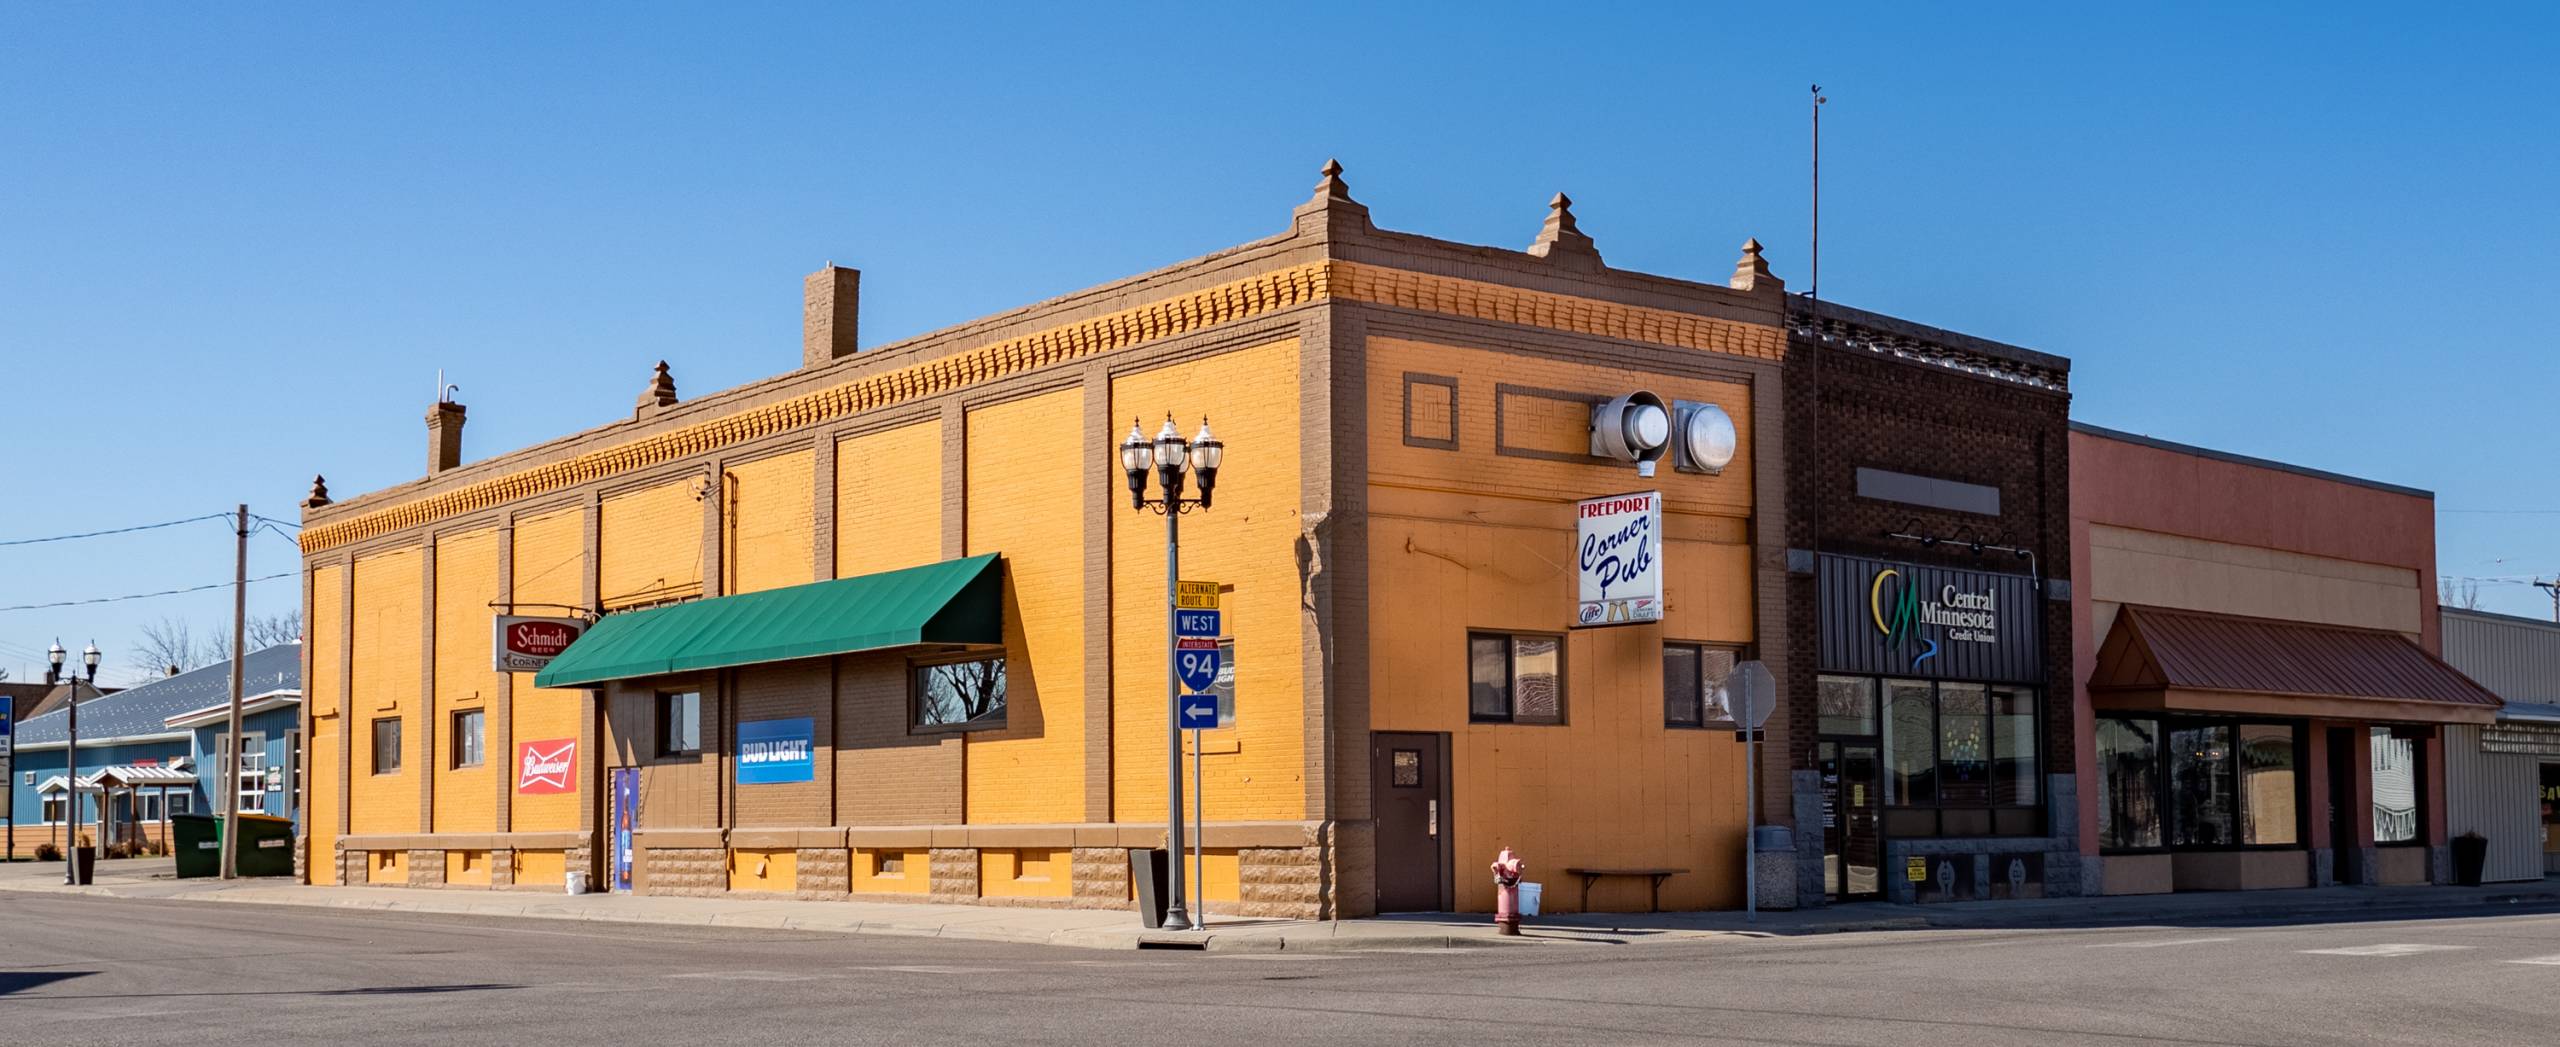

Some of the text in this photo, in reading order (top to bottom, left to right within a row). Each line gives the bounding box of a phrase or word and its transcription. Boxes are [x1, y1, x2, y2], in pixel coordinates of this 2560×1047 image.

[1580, 496, 1652, 519] FREEPORT
[1581, 515, 1651, 572] Corner
[1596, 534, 1653, 600] Pub
[1180, 583, 1216, 595] ALTERNATE
[1181, 595, 1215, 607] ROUTE TO
[1942, 584, 1995, 611] Central
[1181, 615, 1215, 631] WEST
[1920, 600, 1995, 630] Minnesota
[517, 624, 568, 648] Schmidt
[1182, 641, 1214, 649] INTERSTATE
[1949, 628, 1995, 643] Credit Union
[1183, 653, 1214, 679] 94
[742, 739, 808, 763] BUD LIGHT
